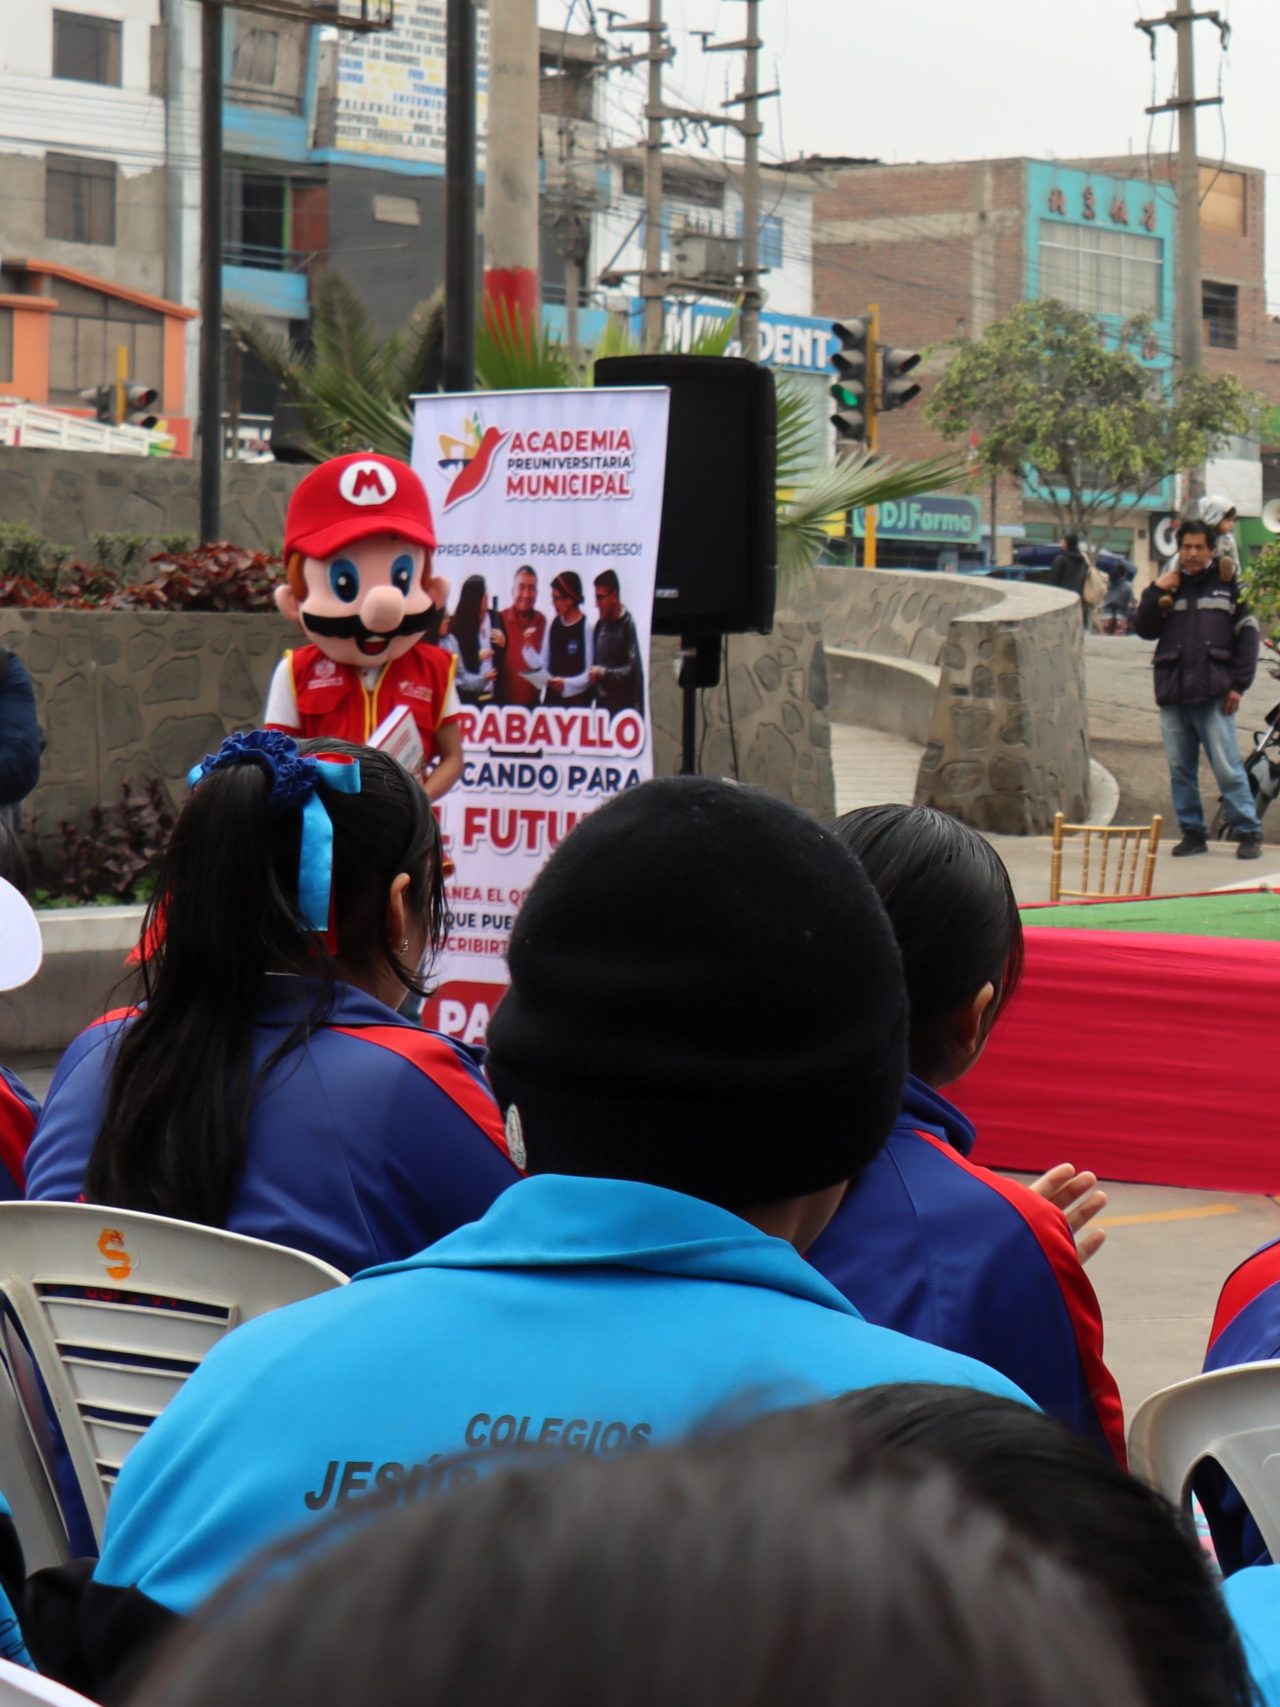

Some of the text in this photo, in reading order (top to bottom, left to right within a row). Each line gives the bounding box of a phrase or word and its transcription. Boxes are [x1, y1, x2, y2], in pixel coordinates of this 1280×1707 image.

[510, 430, 631, 453] ACADEMIA
[507, 456, 631, 470] PREUNIVERSITARIA
[352, 469, 386, 497] M
[506, 474, 630, 497] MUNICIPAL
[531, 543, 568, 557] PARA
[572, 544, 582, 556] EL
[586, 543, 642, 557] INGRESO!
[461, 713, 641, 750] RABAYLLO
[568, 765, 641, 792] PARA
[487, 889, 504, 902] EL
[465, 1413, 651, 1456] COLEGIOS
